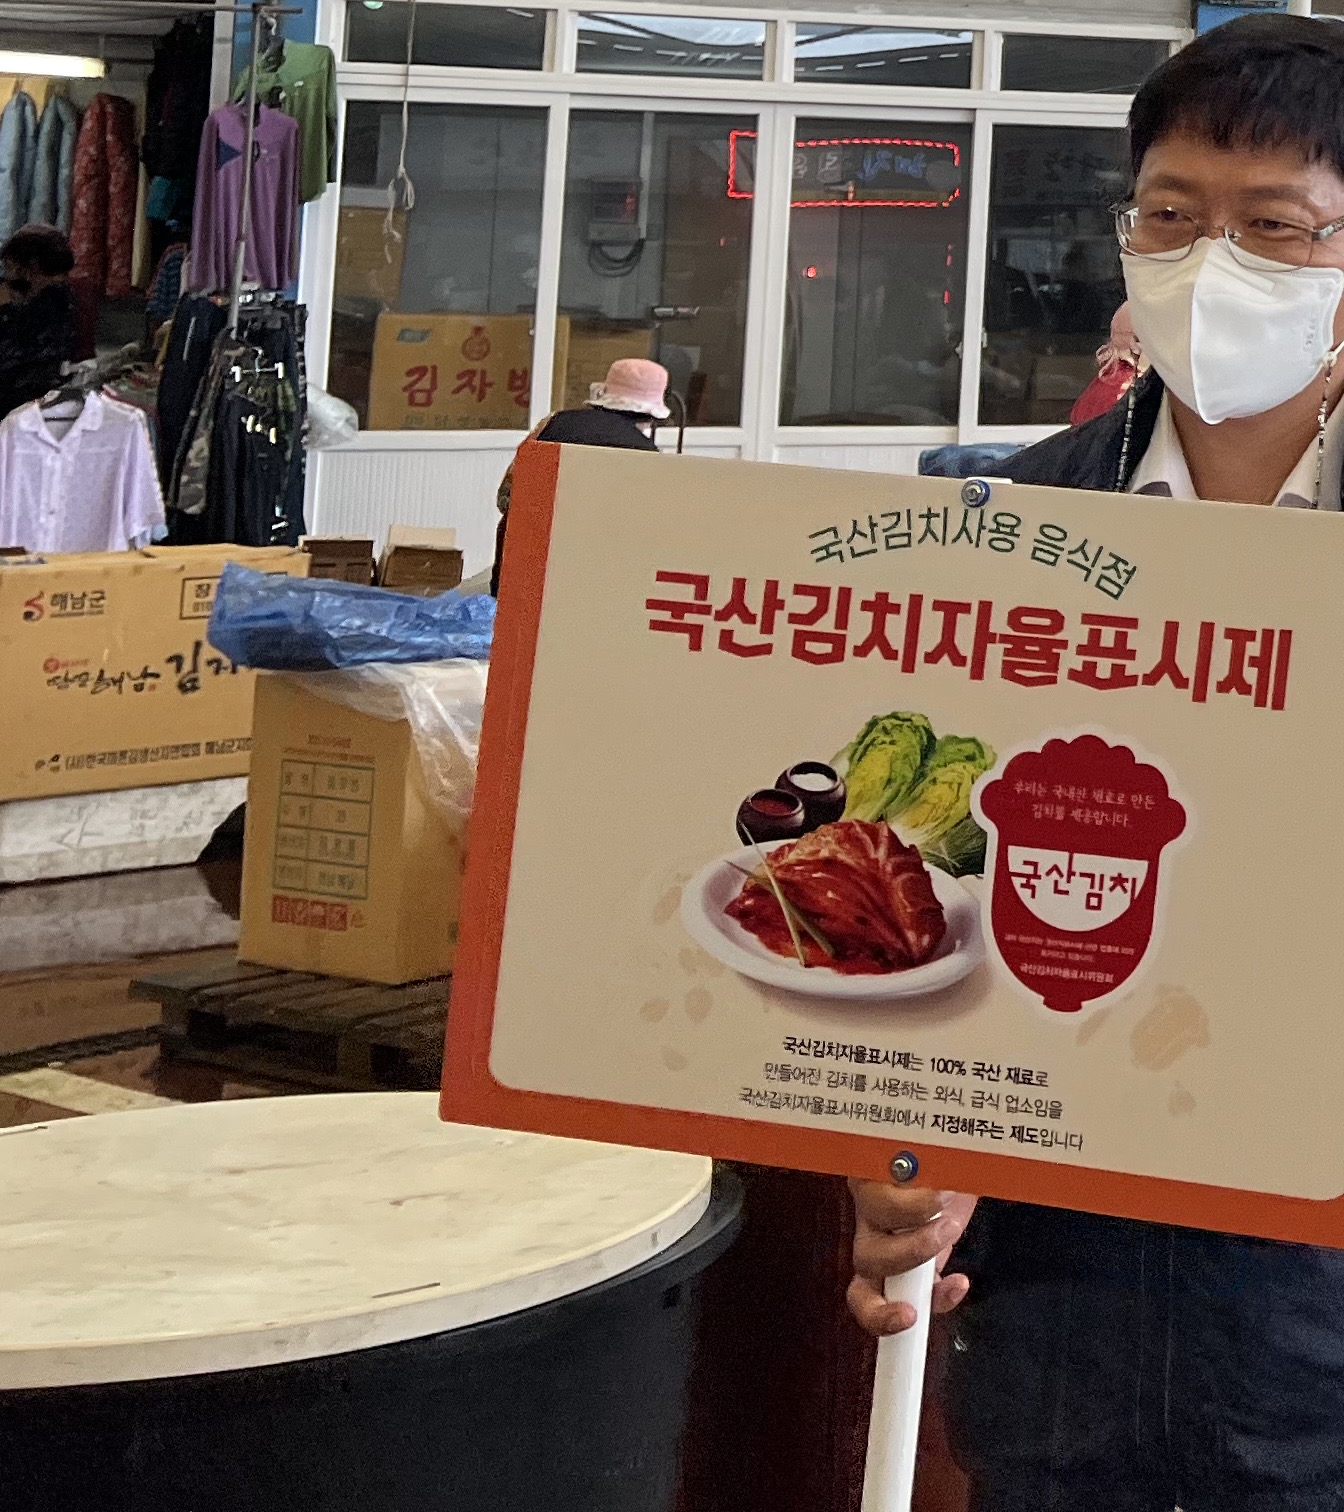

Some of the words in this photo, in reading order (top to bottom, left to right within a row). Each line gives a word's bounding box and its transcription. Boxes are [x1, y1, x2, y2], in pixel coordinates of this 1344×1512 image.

[808, 503, 1020, 567] 국산김치사용
[1030, 519, 1138, 602] 음식점
[50, 589, 106, 611] 해남군
[644, 568, 1292, 712] 국산김치자율표시제
[1009, 852, 1138, 911] 국산김치
[763, 1062, 822, 1087] 만들어진
[826, 1070, 868, 1093] 김치를
[871, 1076, 929, 1102] 사용하는
[970, 1090, 1001, 1112] 급식
[1005, 1094, 1063, 1120] 업소임을
[782, 1036, 925, 1072] 국산김치자율표시제는
[930, 1057, 967, 1077] 100%
[971, 1060, 1001, 1083] 국산
[1005, 1066, 1049, 1088] 재료로
[739, 1086, 927, 1130] 국산김치자율표시위원회에서
[931, 1113, 1005, 1141] 지정해주는
[1008, 1124, 1084, 1152] 제도입니다
